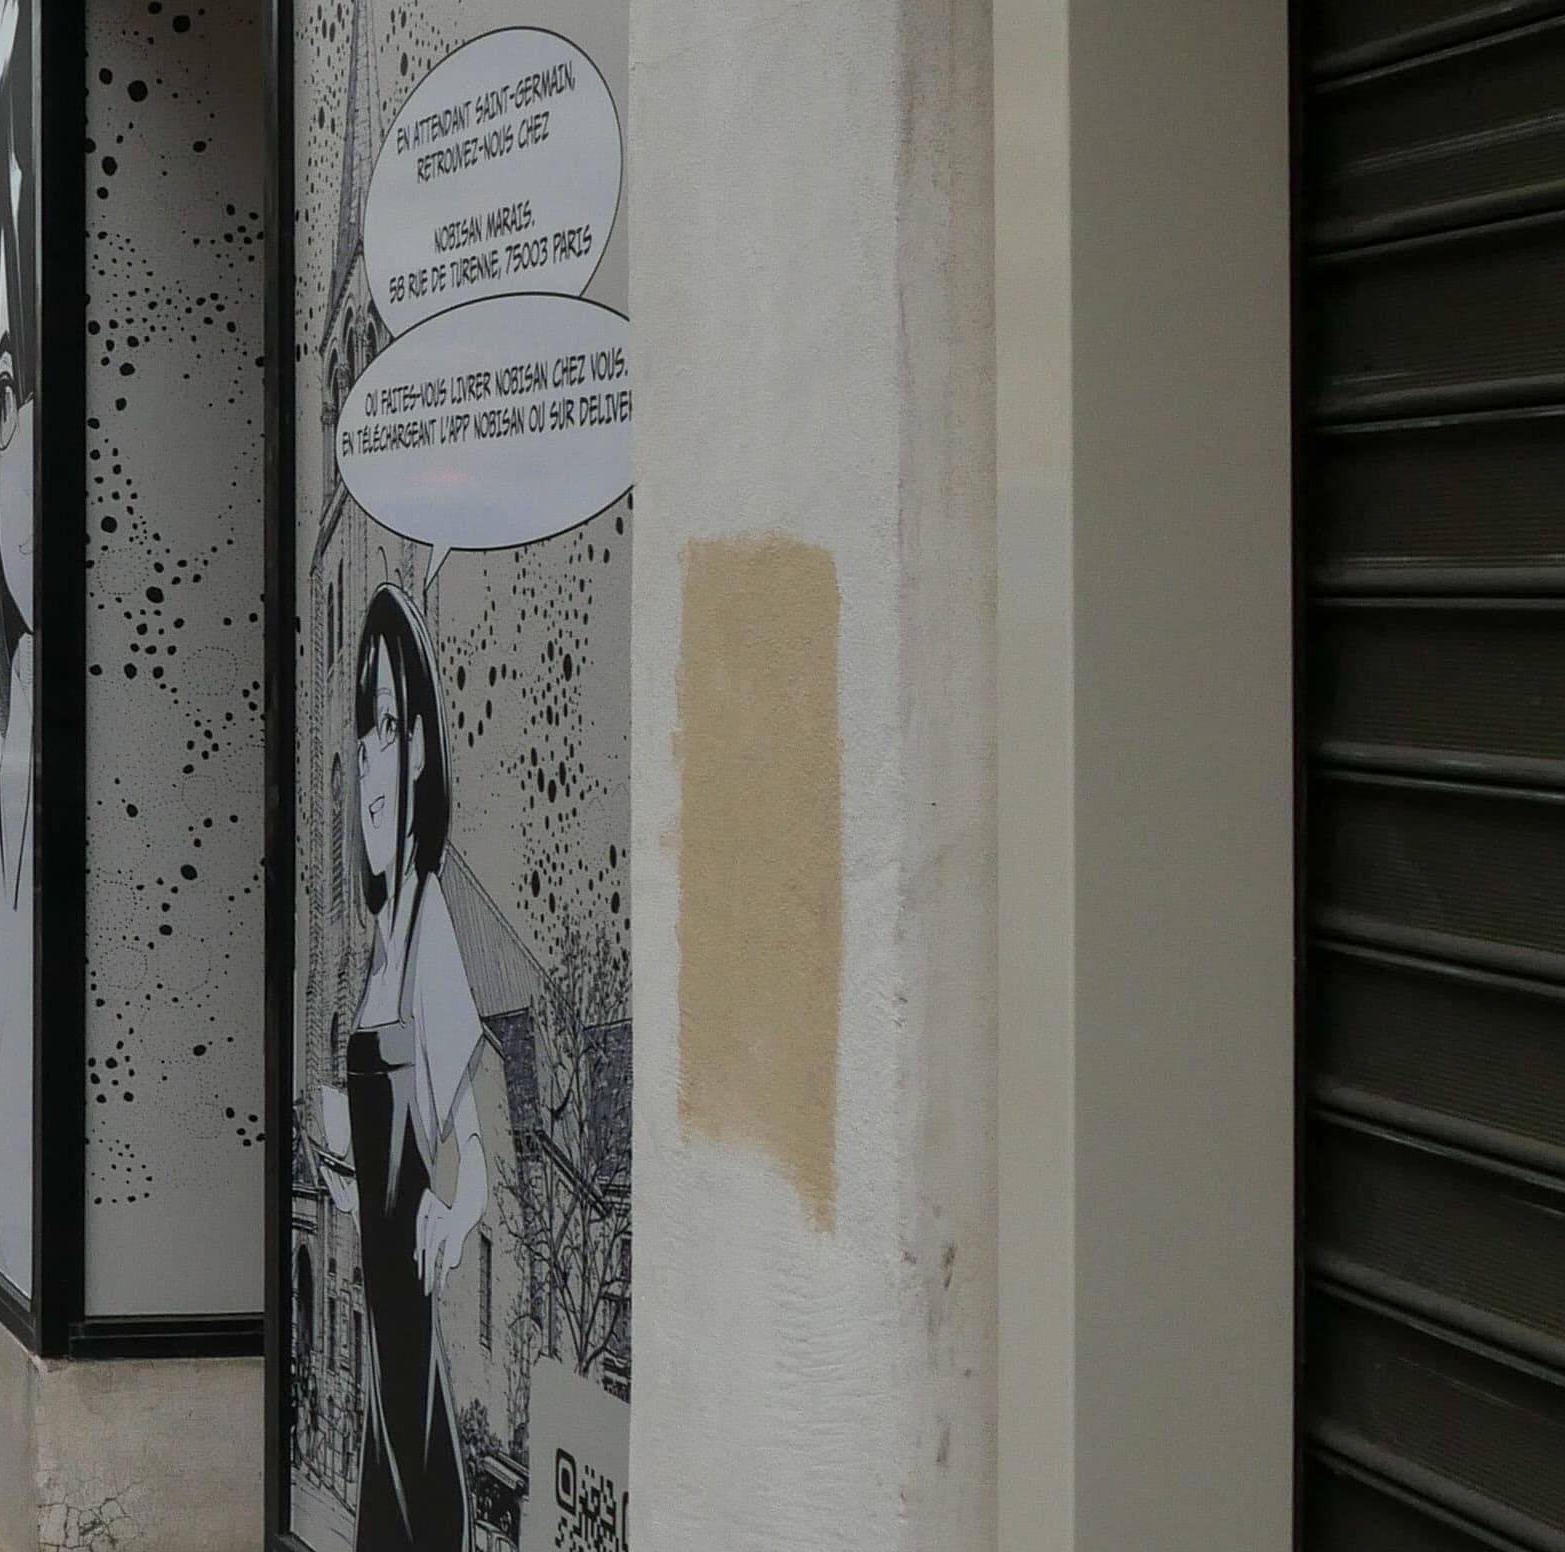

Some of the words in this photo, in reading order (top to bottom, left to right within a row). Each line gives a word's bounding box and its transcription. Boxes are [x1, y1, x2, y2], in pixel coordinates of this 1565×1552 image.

[397, 123, 411, 154] EN
[413, 100, 472, 148] ATTENDANT
[417, 124, 514, 183] RETROUVEZ-NOUS
[518, 111, 550, 148] CHEZ
[434, 214, 482, 254] NOBISAN
[486, 200, 536, 240] MARAIS.
[389, 275, 405, 304] 58
[408, 268, 428, 298] RUE
[431, 264, 446, 293] DE
[450, 250, 502, 288] TURENNE,
[505, 236, 548, 274] 75003
[553, 224, 592, 264] PARIS
[364, 389, 378, 418] OU
[380, 378, 446, 417] FAITES-VOUS
[451, 371, 491, 405] LIVRER
[494, 361, 548, 398] NOBISAN
[552, 353, 586, 389] CHEZ
[590, 347, 628, 382] VOUS.
[342, 431, 354, 458] EN
[356, 418, 438, 454] TÉLÉCHARGEANT
[440, 413, 470, 445] L'APP
[473, 404, 524, 440] NOBISAN
[528, 400, 546, 434] OU
[550, 396, 574, 430] SUR
